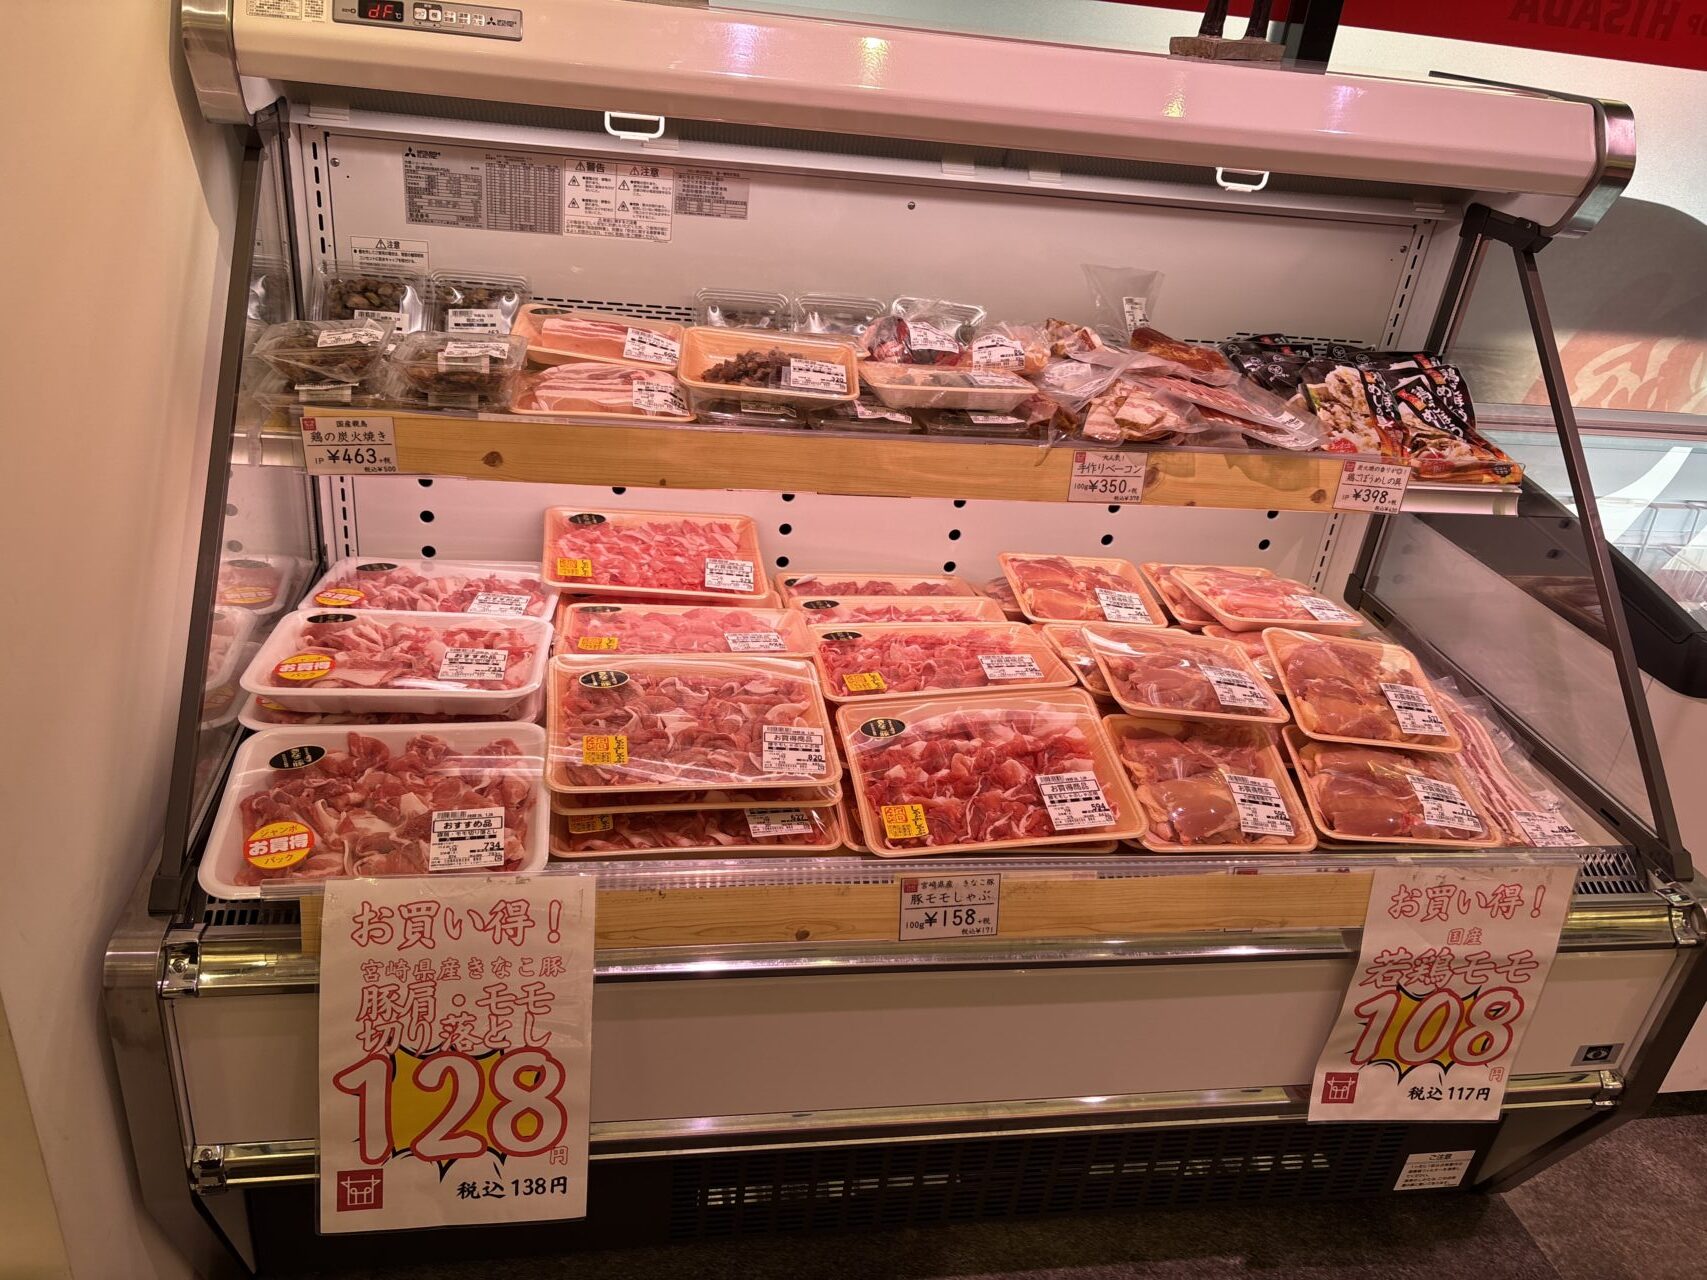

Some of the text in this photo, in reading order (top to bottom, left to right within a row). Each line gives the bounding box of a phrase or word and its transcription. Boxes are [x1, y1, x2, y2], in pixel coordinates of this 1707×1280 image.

[587, 162, 605, 173] 警告
[641, 166, 659, 177] 注意
[387, 241, 400, 250] 注意
[310, 431, 386, 443] 鶏の炭火焼き
[327, 448, 377, 464] ¥463
[1077, 462, 1142, 474] 手作りベーコン
[1089, 479, 1127, 493] ¥350
[1352, 488, 1389, 504] ¥398
[443, 819, 493, 830] おすすめ品
[249, 833, 308, 856] お買得
[484, 841, 500, 850] 734
[921, 878, 995, 889] 宮崎県産 きなこ豚
[911, 890, 991, 905] 豚モモしゃぶ
[1388, 883, 1546, 922] お買い得！
[351, 899, 561, 950] お買い得！
[905, 921, 924, 929] 100g
[924, 908, 976, 927] ¥158
[1447, 927, 1482, 945] 国産
[360, 956, 566, 983] 宮崎県産きなこ豚
[1358, 946, 1539, 988] 若鶏モモ
[356, 981, 555, 1022] 豚肩・モモ
[356, 1011, 552, 1056] 切り落とし
[1350, 986, 1524, 1082] 108 円
[333, 1046, 568, 1165] 128 円
